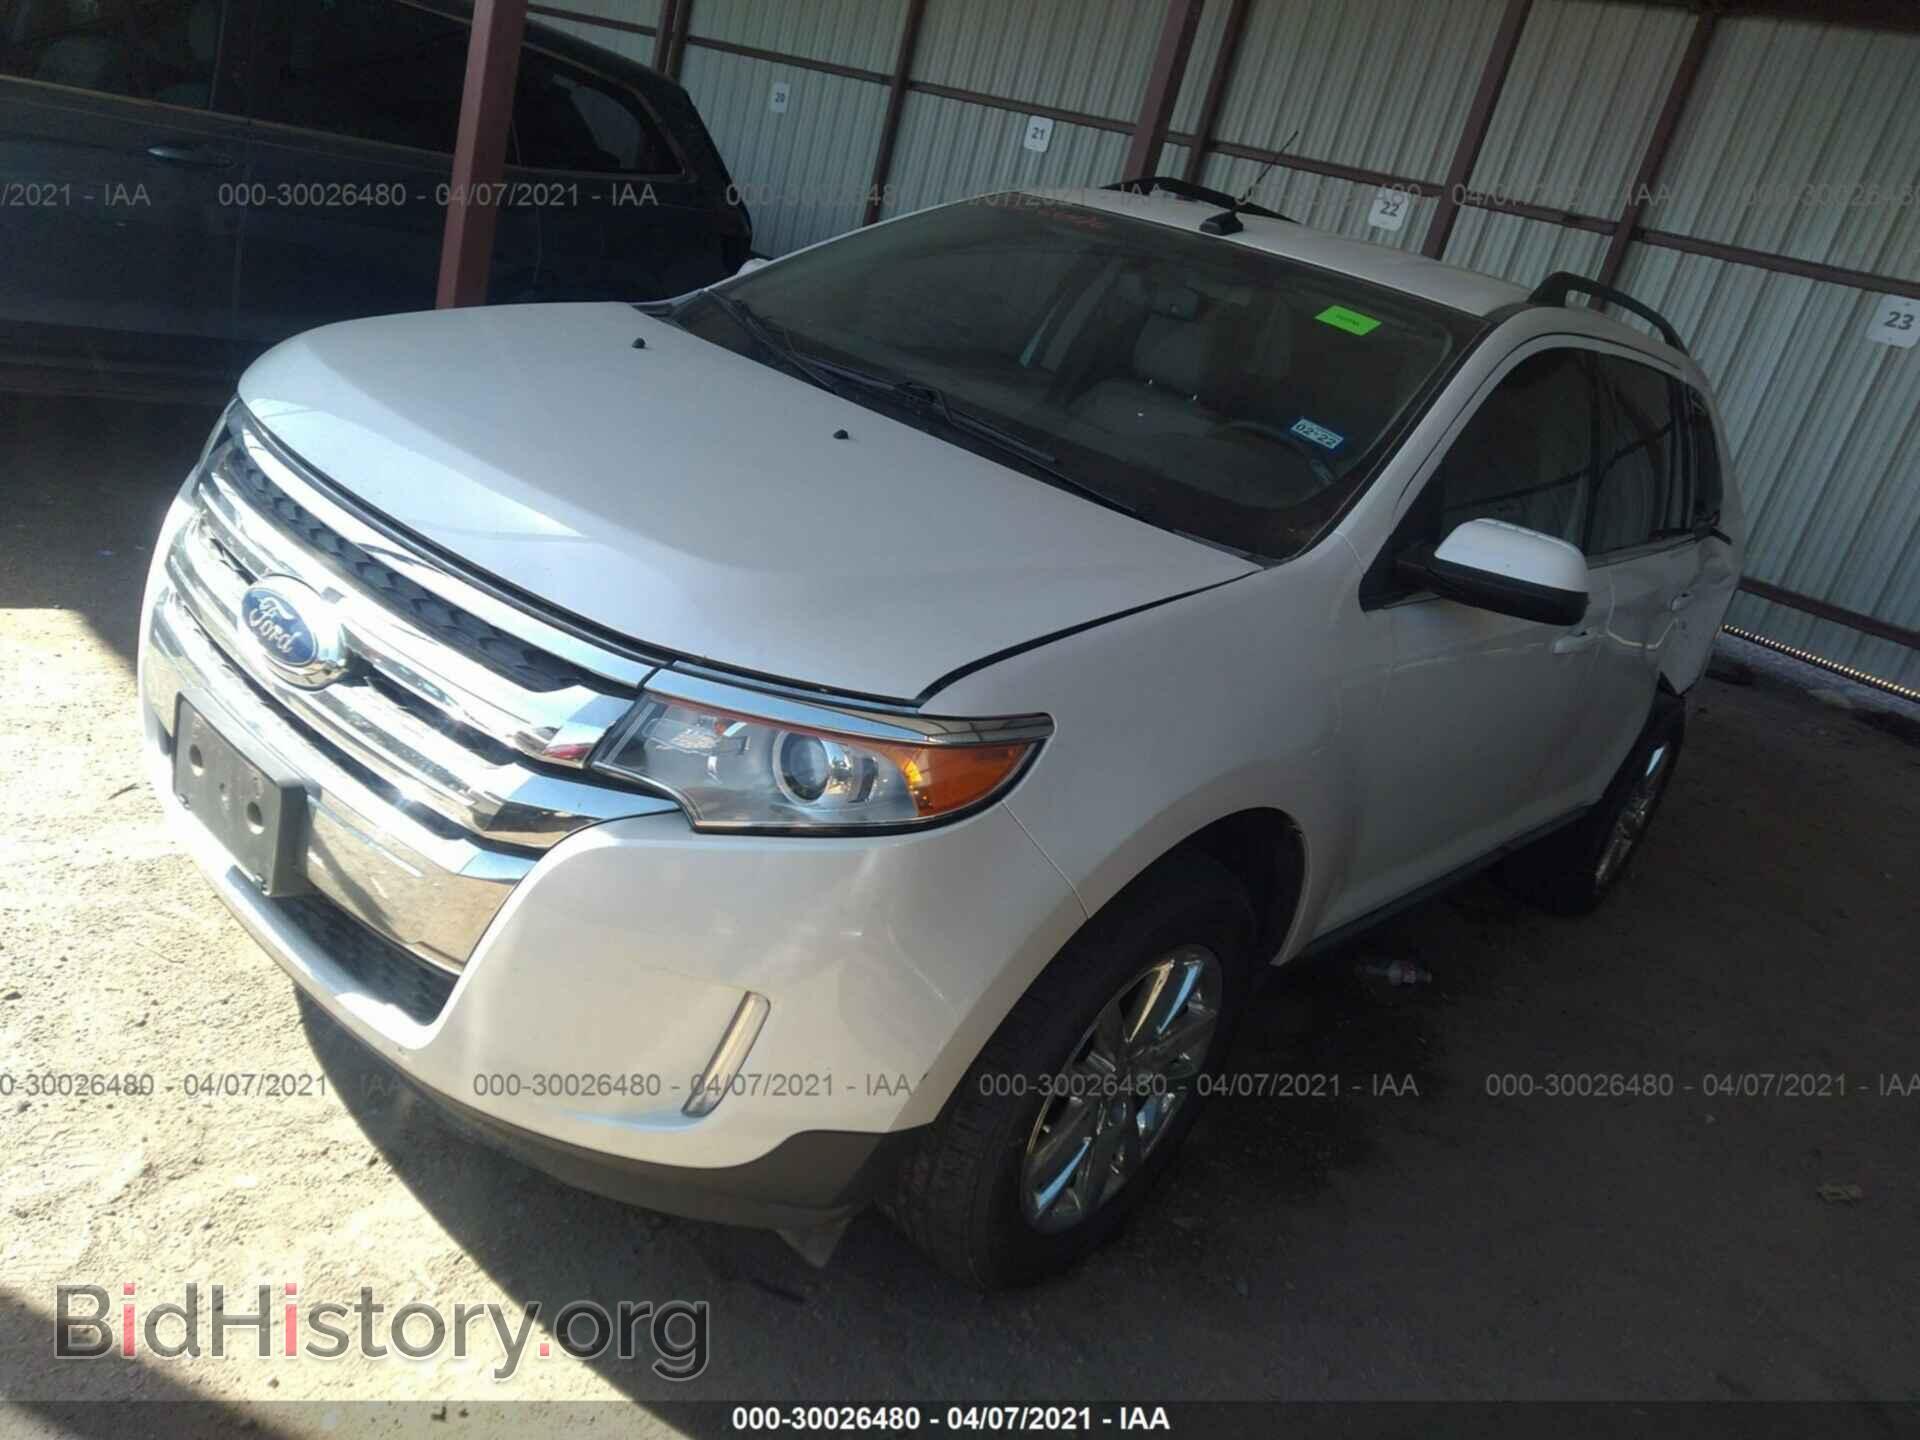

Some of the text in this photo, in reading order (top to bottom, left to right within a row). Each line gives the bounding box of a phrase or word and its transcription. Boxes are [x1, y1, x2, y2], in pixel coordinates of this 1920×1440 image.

[1031, 127, 1045, 141] 21
[1379, 200, 1399, 217] 22
[1884, 311, 1914, 330] 23
[249, 597, 303, 653] Ford
